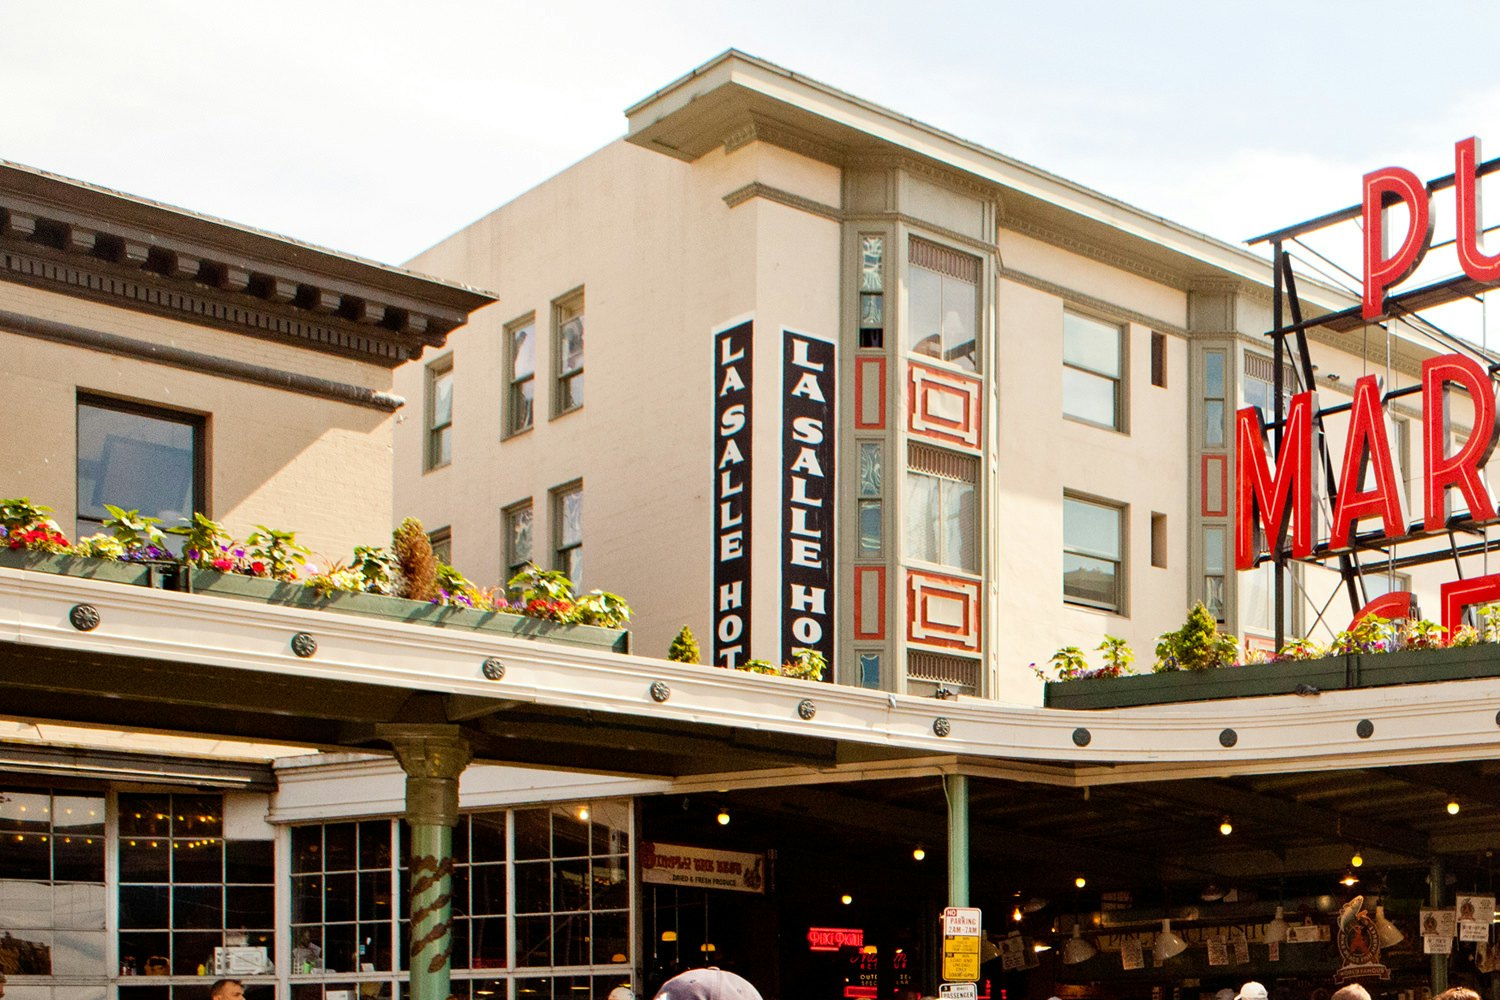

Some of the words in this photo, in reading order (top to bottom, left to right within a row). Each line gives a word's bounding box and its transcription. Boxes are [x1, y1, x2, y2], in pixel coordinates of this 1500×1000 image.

[719, 335, 745, 398] LA
[790, 337, 826, 403] LA
[718, 403, 746, 563] SALLE
[790, 415, 825, 570] SALLE
[943, 991, 973, 999] PASSENGER
